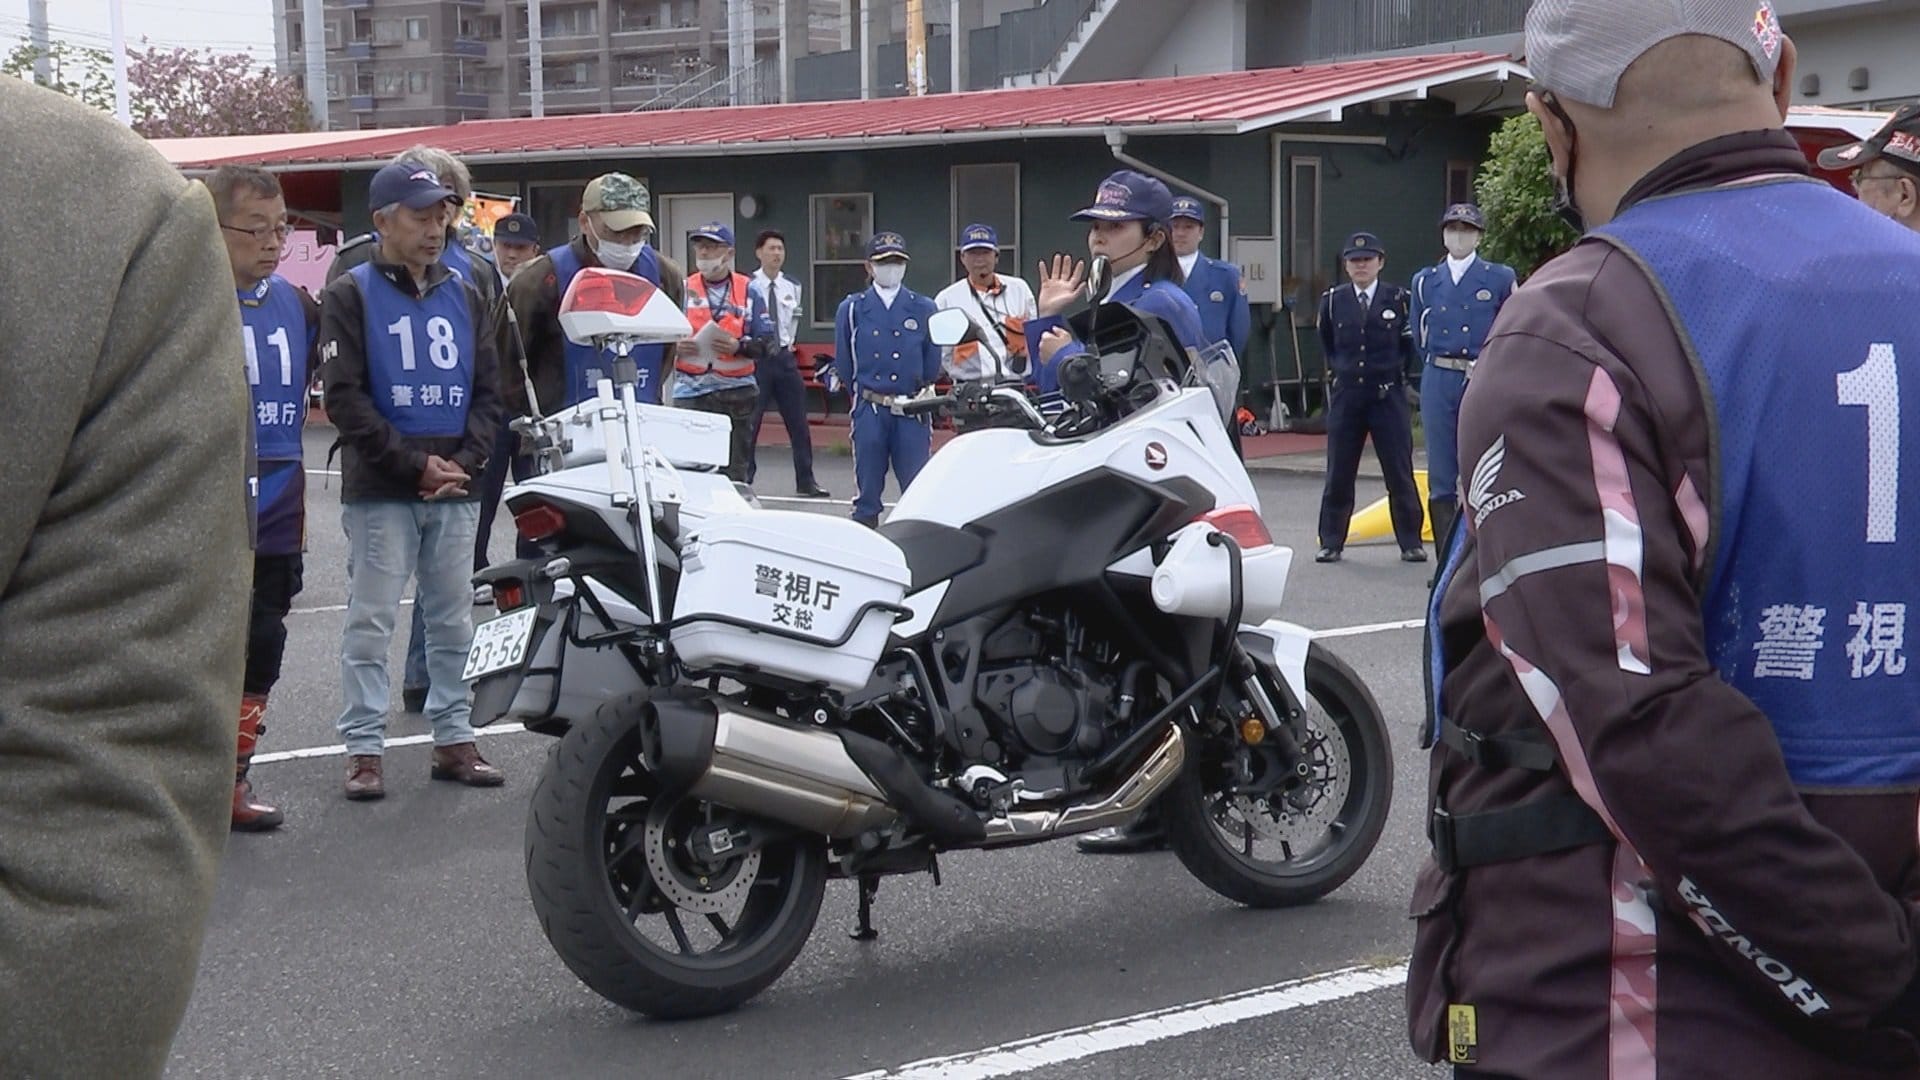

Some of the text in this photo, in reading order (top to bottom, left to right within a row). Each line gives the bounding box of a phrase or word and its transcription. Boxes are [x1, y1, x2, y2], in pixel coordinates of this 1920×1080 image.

[388, 315, 459, 371] 18
[391, 384, 464, 407] 警視庁
[585, 367, 649, 389] 警庁
[1837, 343, 1899, 542] 1
[754, 564, 841, 611] 警視庁
[772, 602, 814, 631] 交総
[1753, 601, 1906, 680] 警視
[1677, 875, 1831, 1016] HONDA
